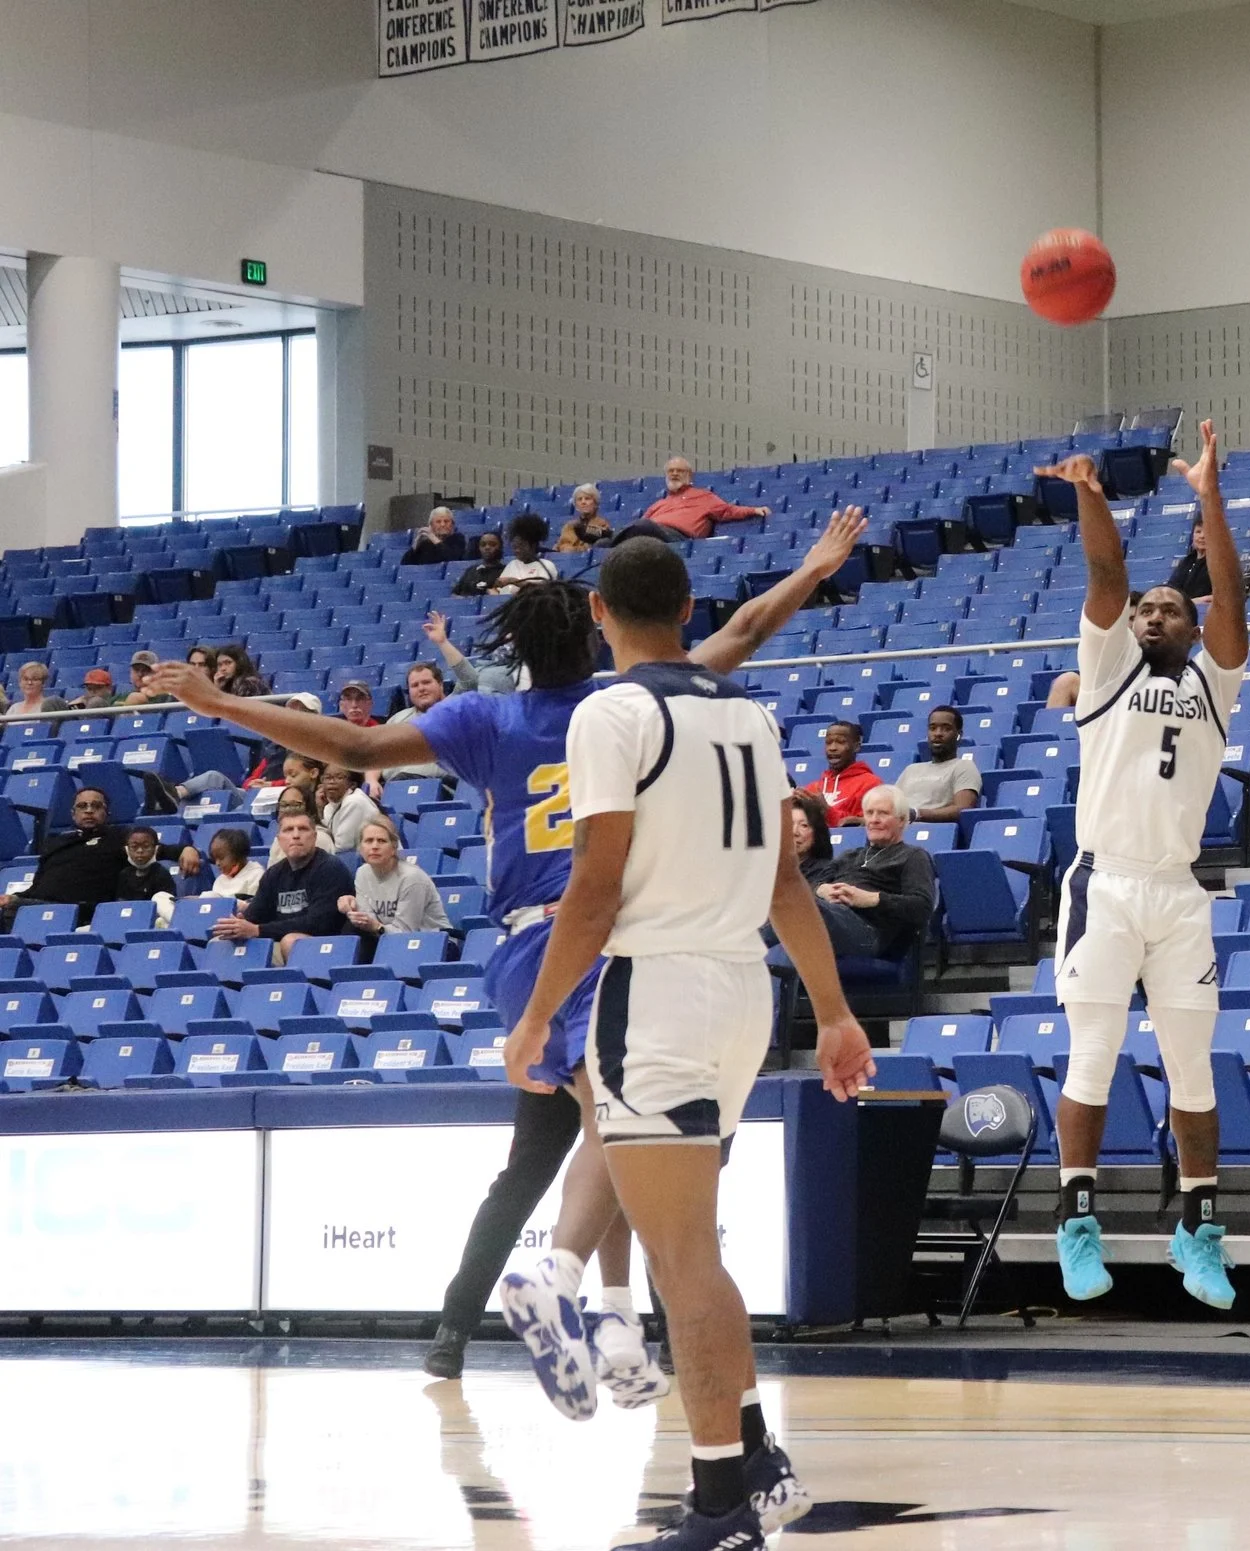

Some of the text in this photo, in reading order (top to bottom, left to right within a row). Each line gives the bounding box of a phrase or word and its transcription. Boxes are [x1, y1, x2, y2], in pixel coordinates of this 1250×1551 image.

[248, 262, 264, 281] EXIT
[1159, 726, 1182, 780] 5
[525, 761, 573, 854] 2
[711, 741, 765, 850] 11
[323, 1225, 396, 1249] iHeart
